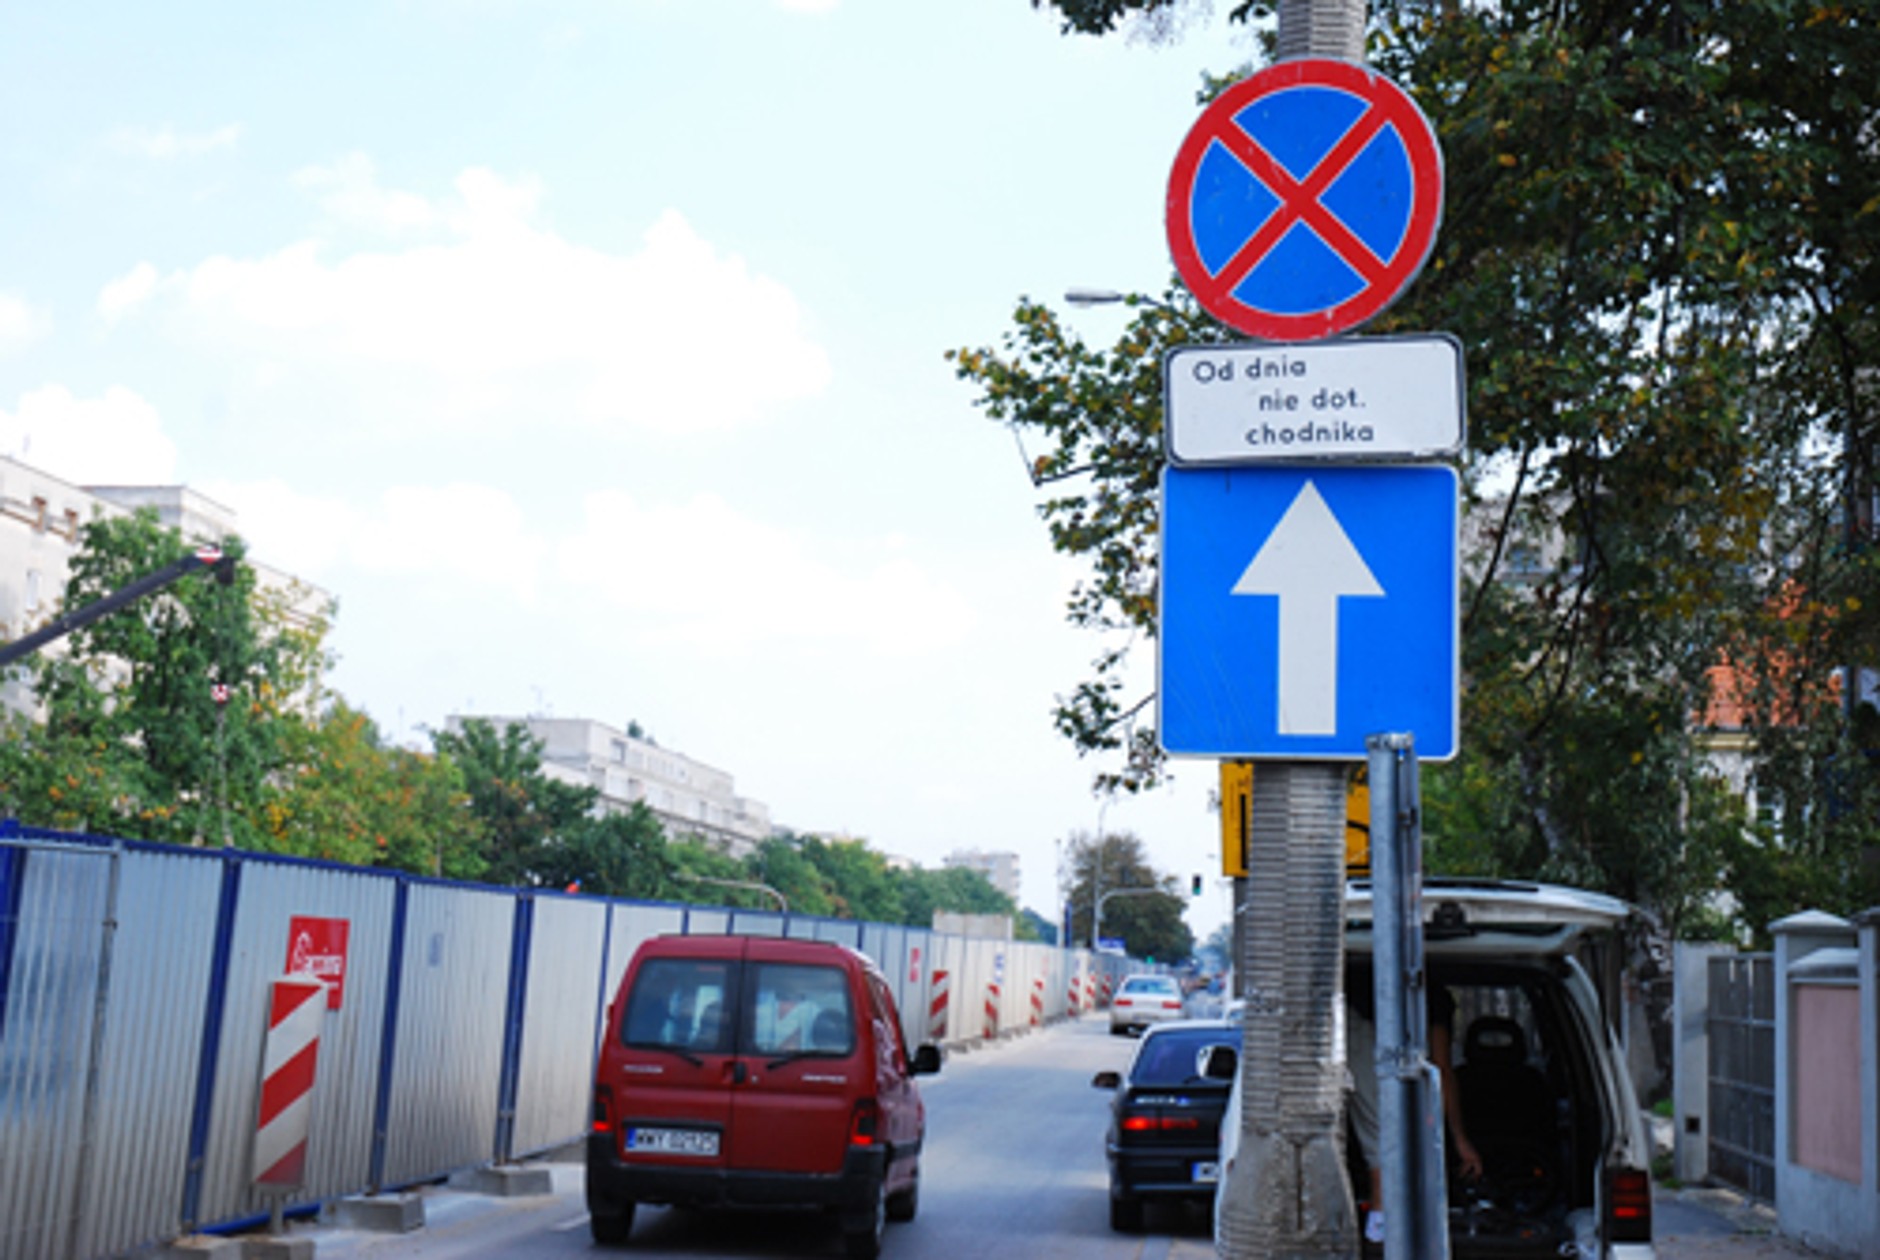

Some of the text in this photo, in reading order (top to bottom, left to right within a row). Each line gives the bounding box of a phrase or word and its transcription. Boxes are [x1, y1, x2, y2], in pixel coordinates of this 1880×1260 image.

[1192, 355, 1307, 383] Od dnia
[1259, 387, 1367, 411] nie dot.
[1245, 420, 1374, 445] chodnika
